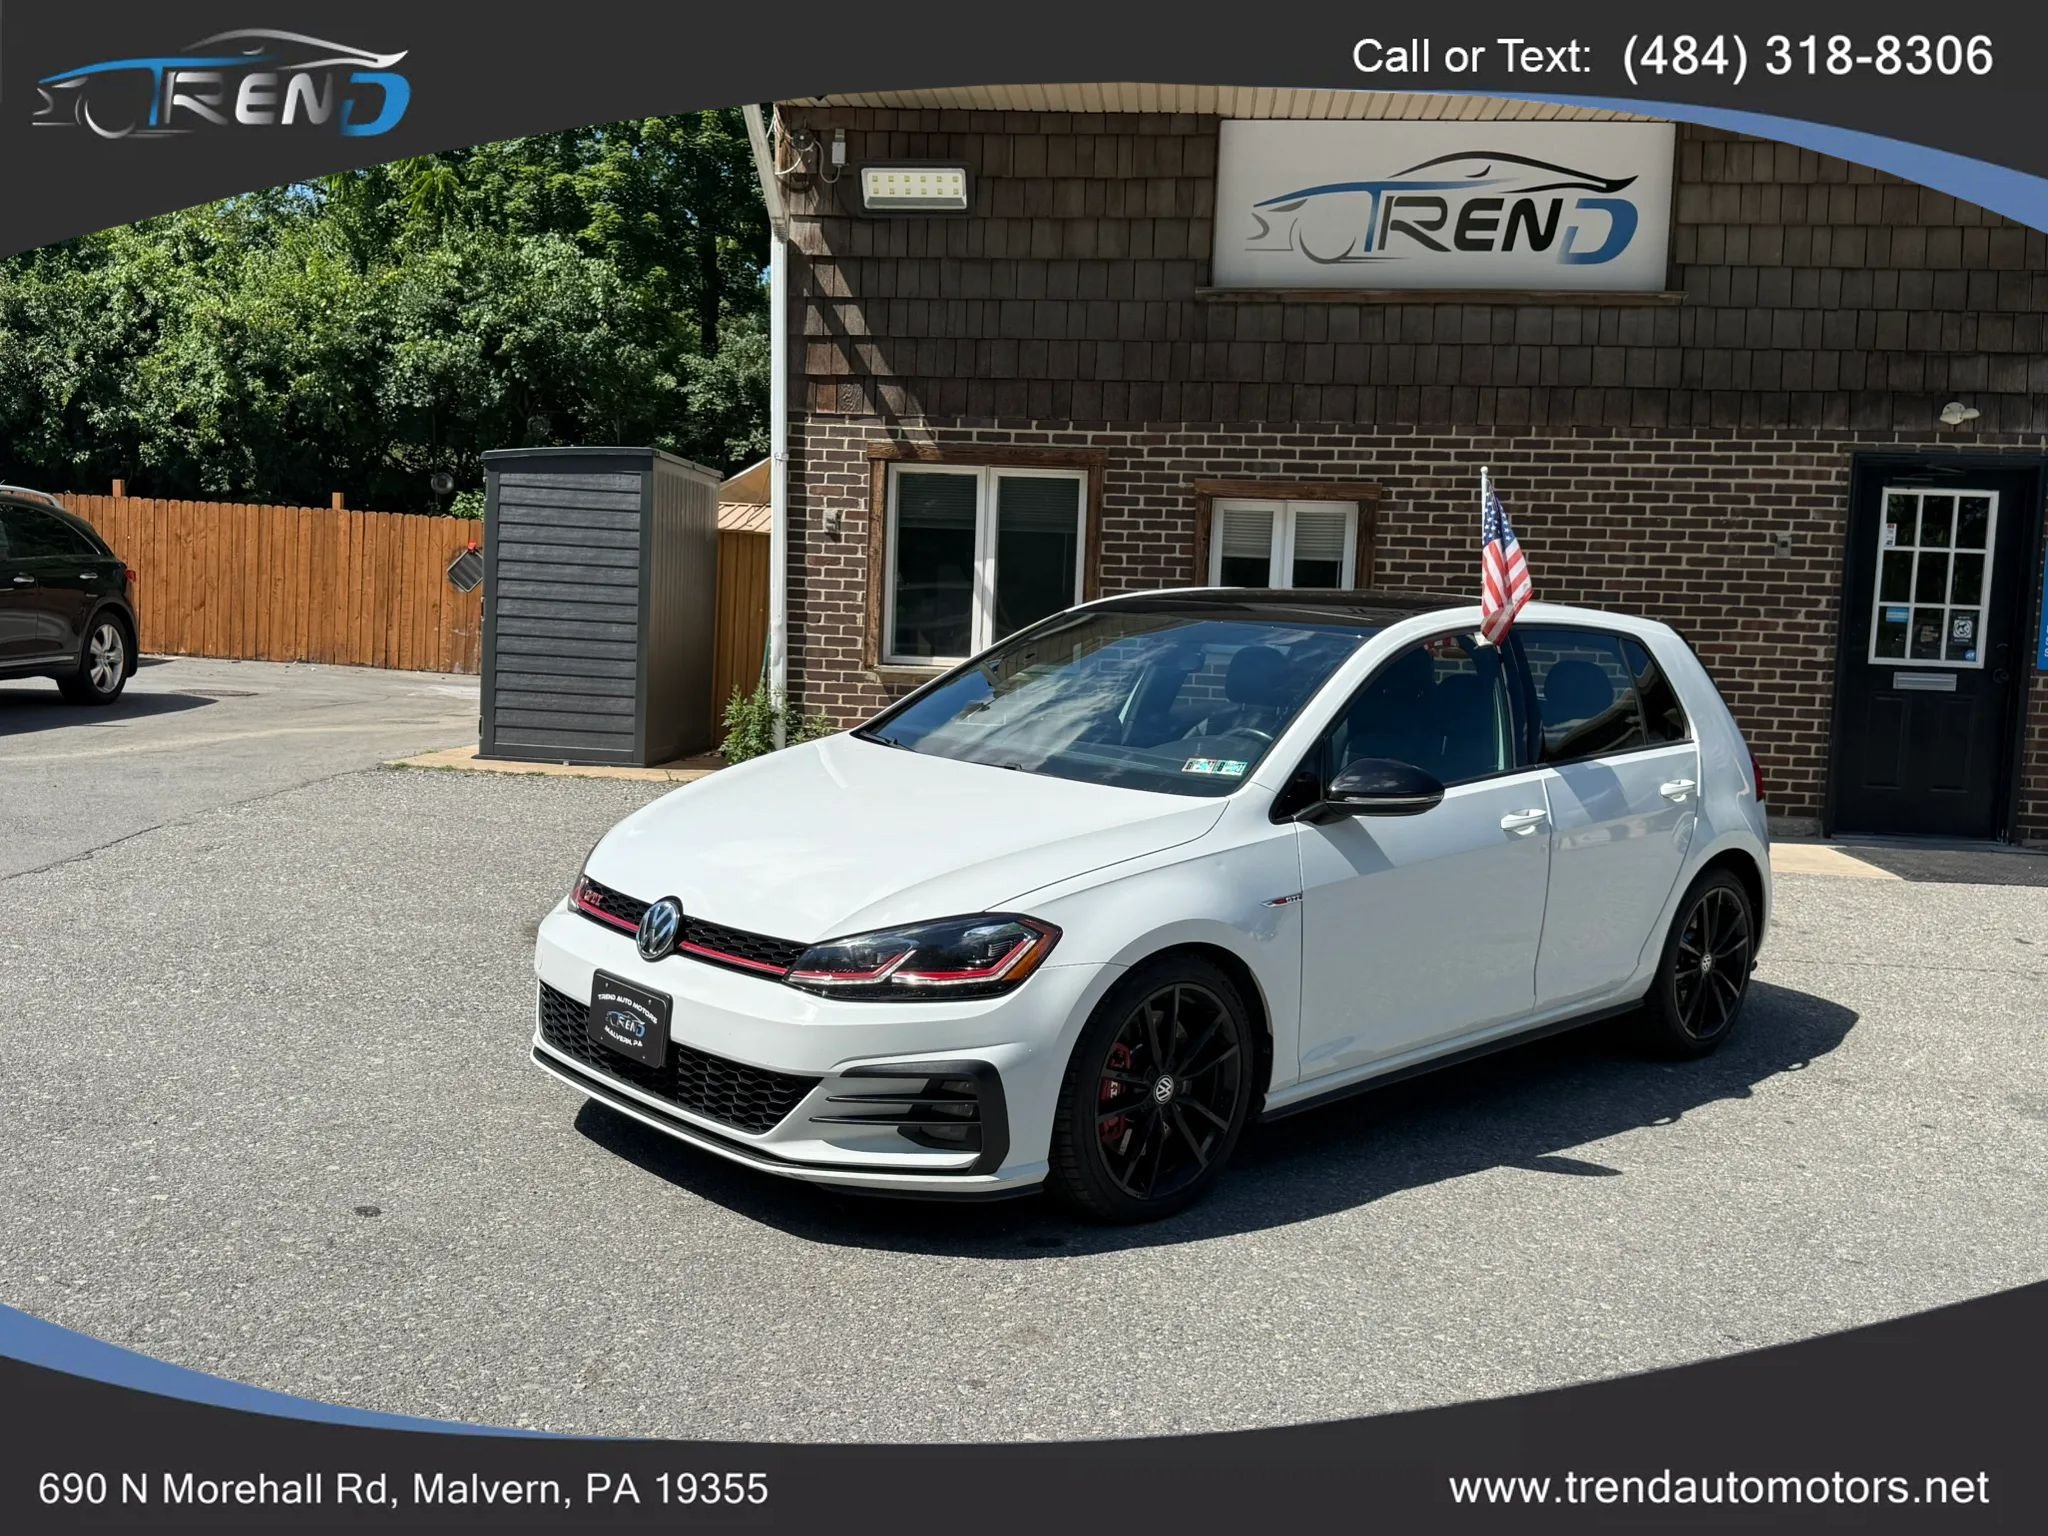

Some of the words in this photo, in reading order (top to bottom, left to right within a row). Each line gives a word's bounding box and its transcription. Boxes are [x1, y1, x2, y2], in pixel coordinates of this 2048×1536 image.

[1335, 180, 1639, 265] TREND
[616, 995, 633, 1006] AUTO
[632, 1002, 659, 1025] MOTORS
